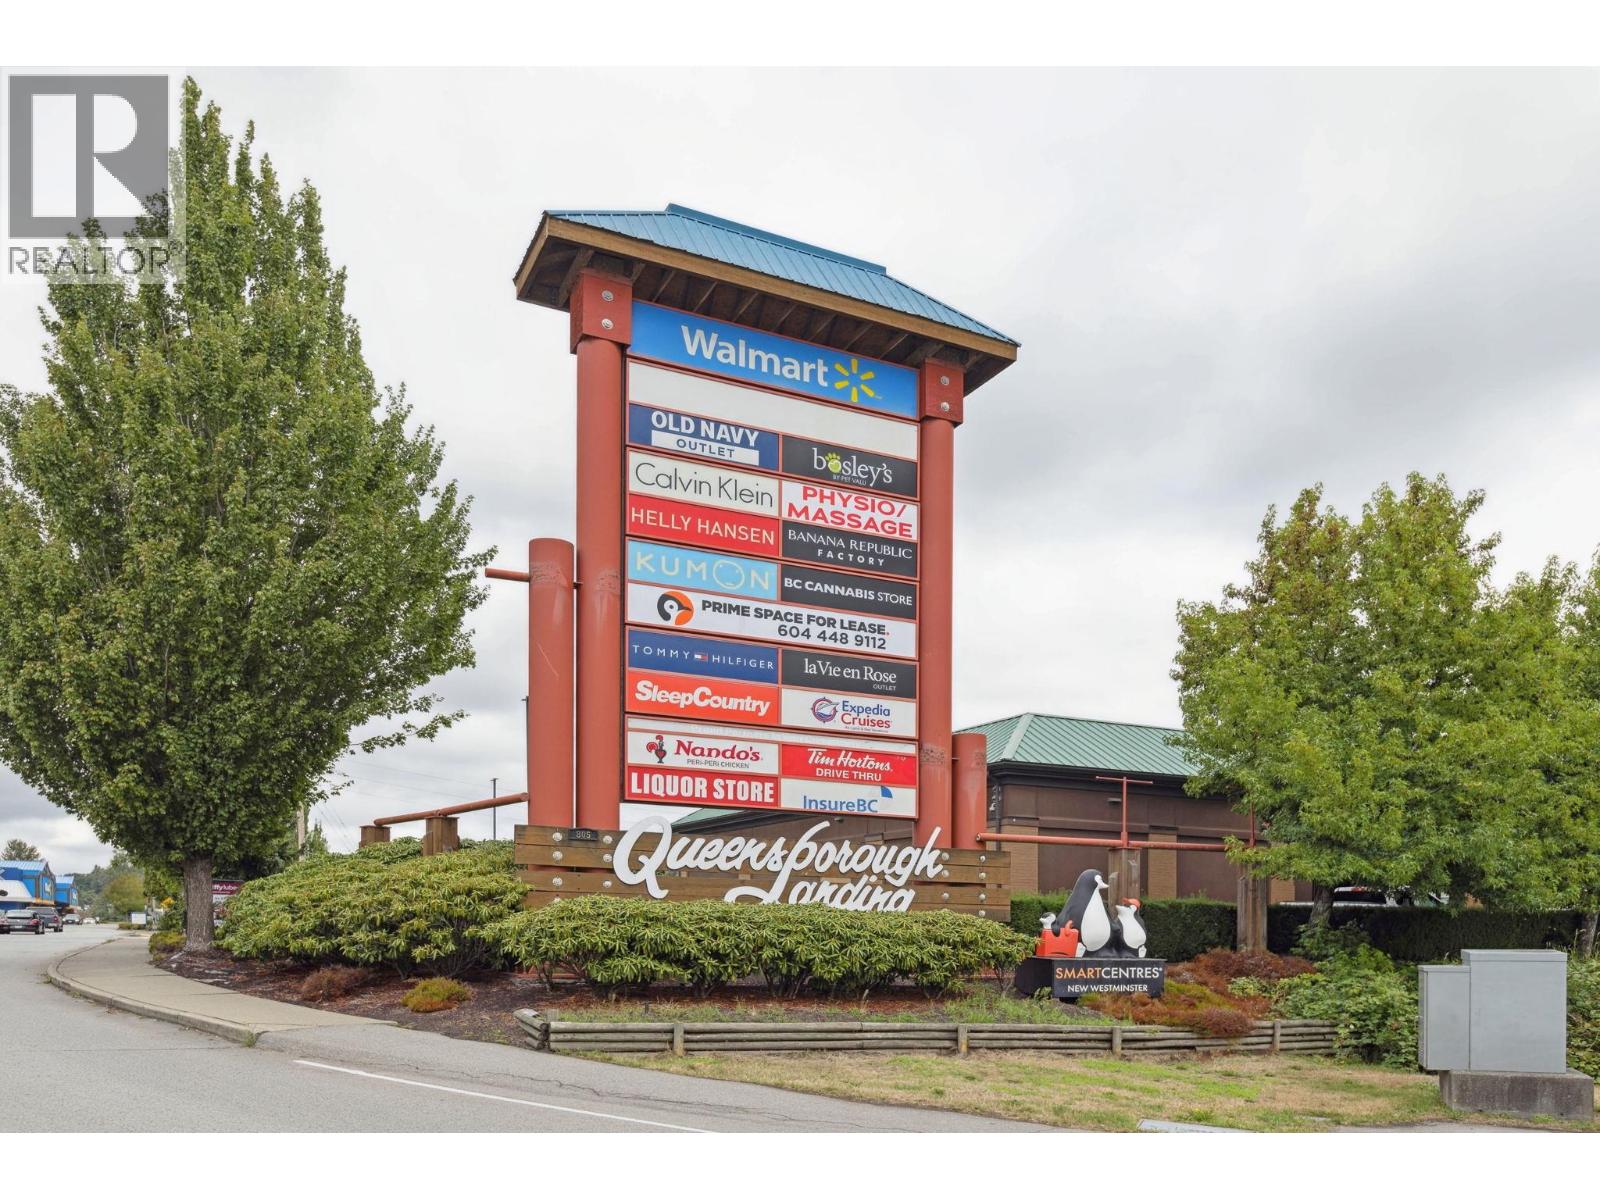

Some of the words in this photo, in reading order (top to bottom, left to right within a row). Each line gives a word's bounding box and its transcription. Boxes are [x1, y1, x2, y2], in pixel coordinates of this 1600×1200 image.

[681, 325, 828, 387] Walmart
[651, 411, 695, 434] OLD
[700, 420, 759, 447] NAVY
[676, 439, 735, 459] OUTLET
[635, 463, 711, 497] Calvin
[718, 476, 773, 507] Klein
[803, 486, 907, 517] PHYSIO/
[631, 507, 691, 531] HELLY
[697, 516, 775, 545] HANSEN
[788, 502, 912, 538] MASSAGE
[788, 529, 845, 548] BANANA
[850, 539, 913, 559] REPUBLIC
[817, 549, 884, 566] FACTORY
[635, 552, 769, 590] KUMON
[784, 577, 802, 589] BC
[804, 581, 875, 600] CANNABIS
[877, 592, 913, 606] STORE
[702, 600, 750, 617] PRIME
[753, 607, 803, 624] SPACE
[806, 614, 836, 629] FOR
[778, 624, 811, 640] 604
[817, 630, 849, 645] 448
[855, 635, 886, 650] 9112
[632, 645, 690, 659] TOMMY
[712, 655, 774, 669] HILFIGER
[843, 668, 860, 679] en
[863, 666, 897, 683] Rose
[873, 683, 896, 691] OUTLET
[635, 680, 771, 716] SleepCountry
[842, 701, 891, 716] Expedia
[841, 713, 891, 728] Cruises
[674, 740, 761, 761] Nando's
[808, 748, 834, 766] Tim
[836, 750, 891, 771] Hortons
[720, 760, 750, 769] CHICKEN
[816, 768, 849, 779] DRIVE
[852, 771, 882, 781] THRU
[631, 772, 708, 798] LIQUOR
[713, 778, 774, 802] STORE
[803, 795, 878, 813] InsureBC
[575, 831, 591, 839] 805
[613, 815, 943, 899] Queensborough
[1090, 984, 1148, 992] WESTMINSTER
